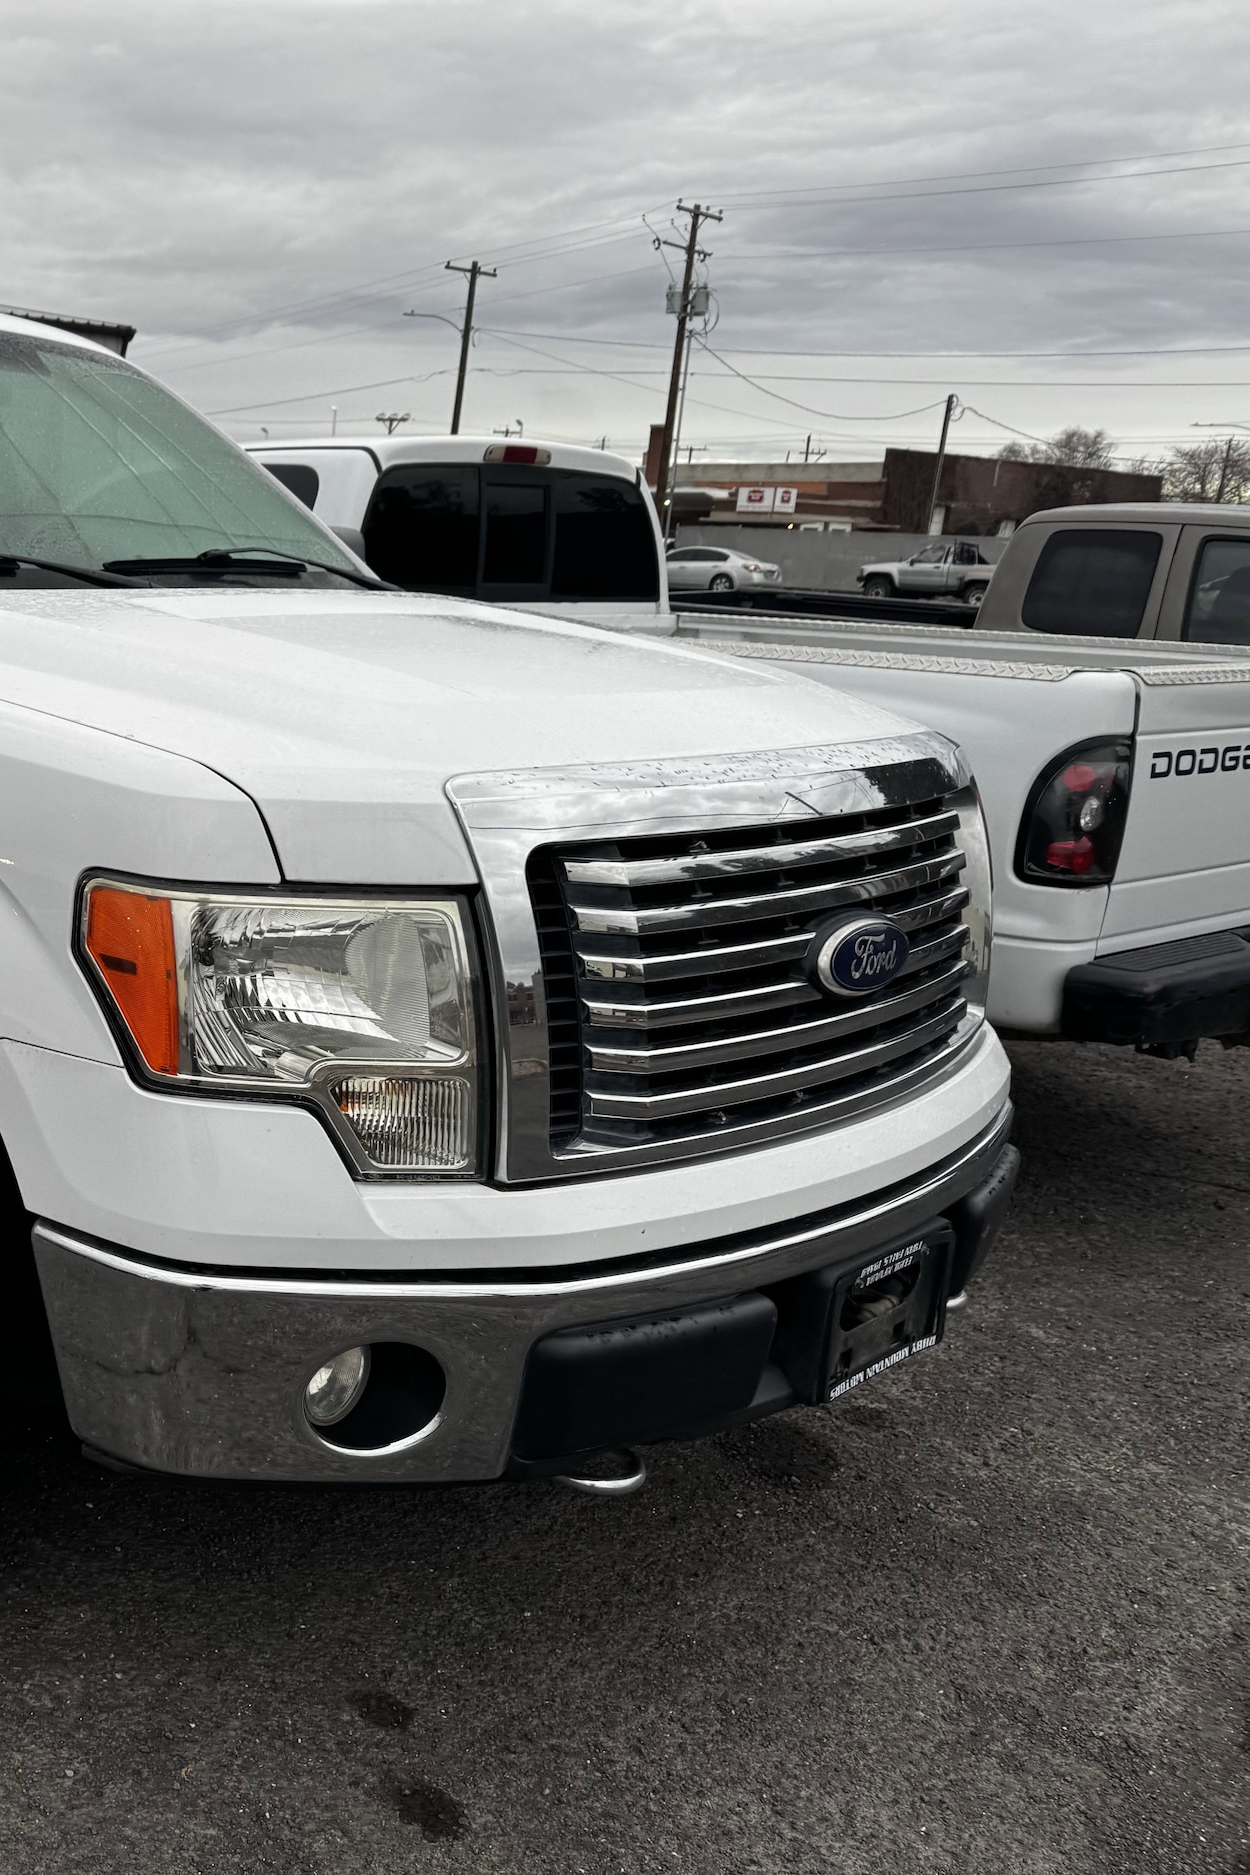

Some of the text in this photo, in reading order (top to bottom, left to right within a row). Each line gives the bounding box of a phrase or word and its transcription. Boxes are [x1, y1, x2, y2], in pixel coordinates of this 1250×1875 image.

[851, 933, 897, 979] Ford
[866, 1346, 910, 1379] MOUNTAIN
[830, 1370, 865, 1402] MOTORS
